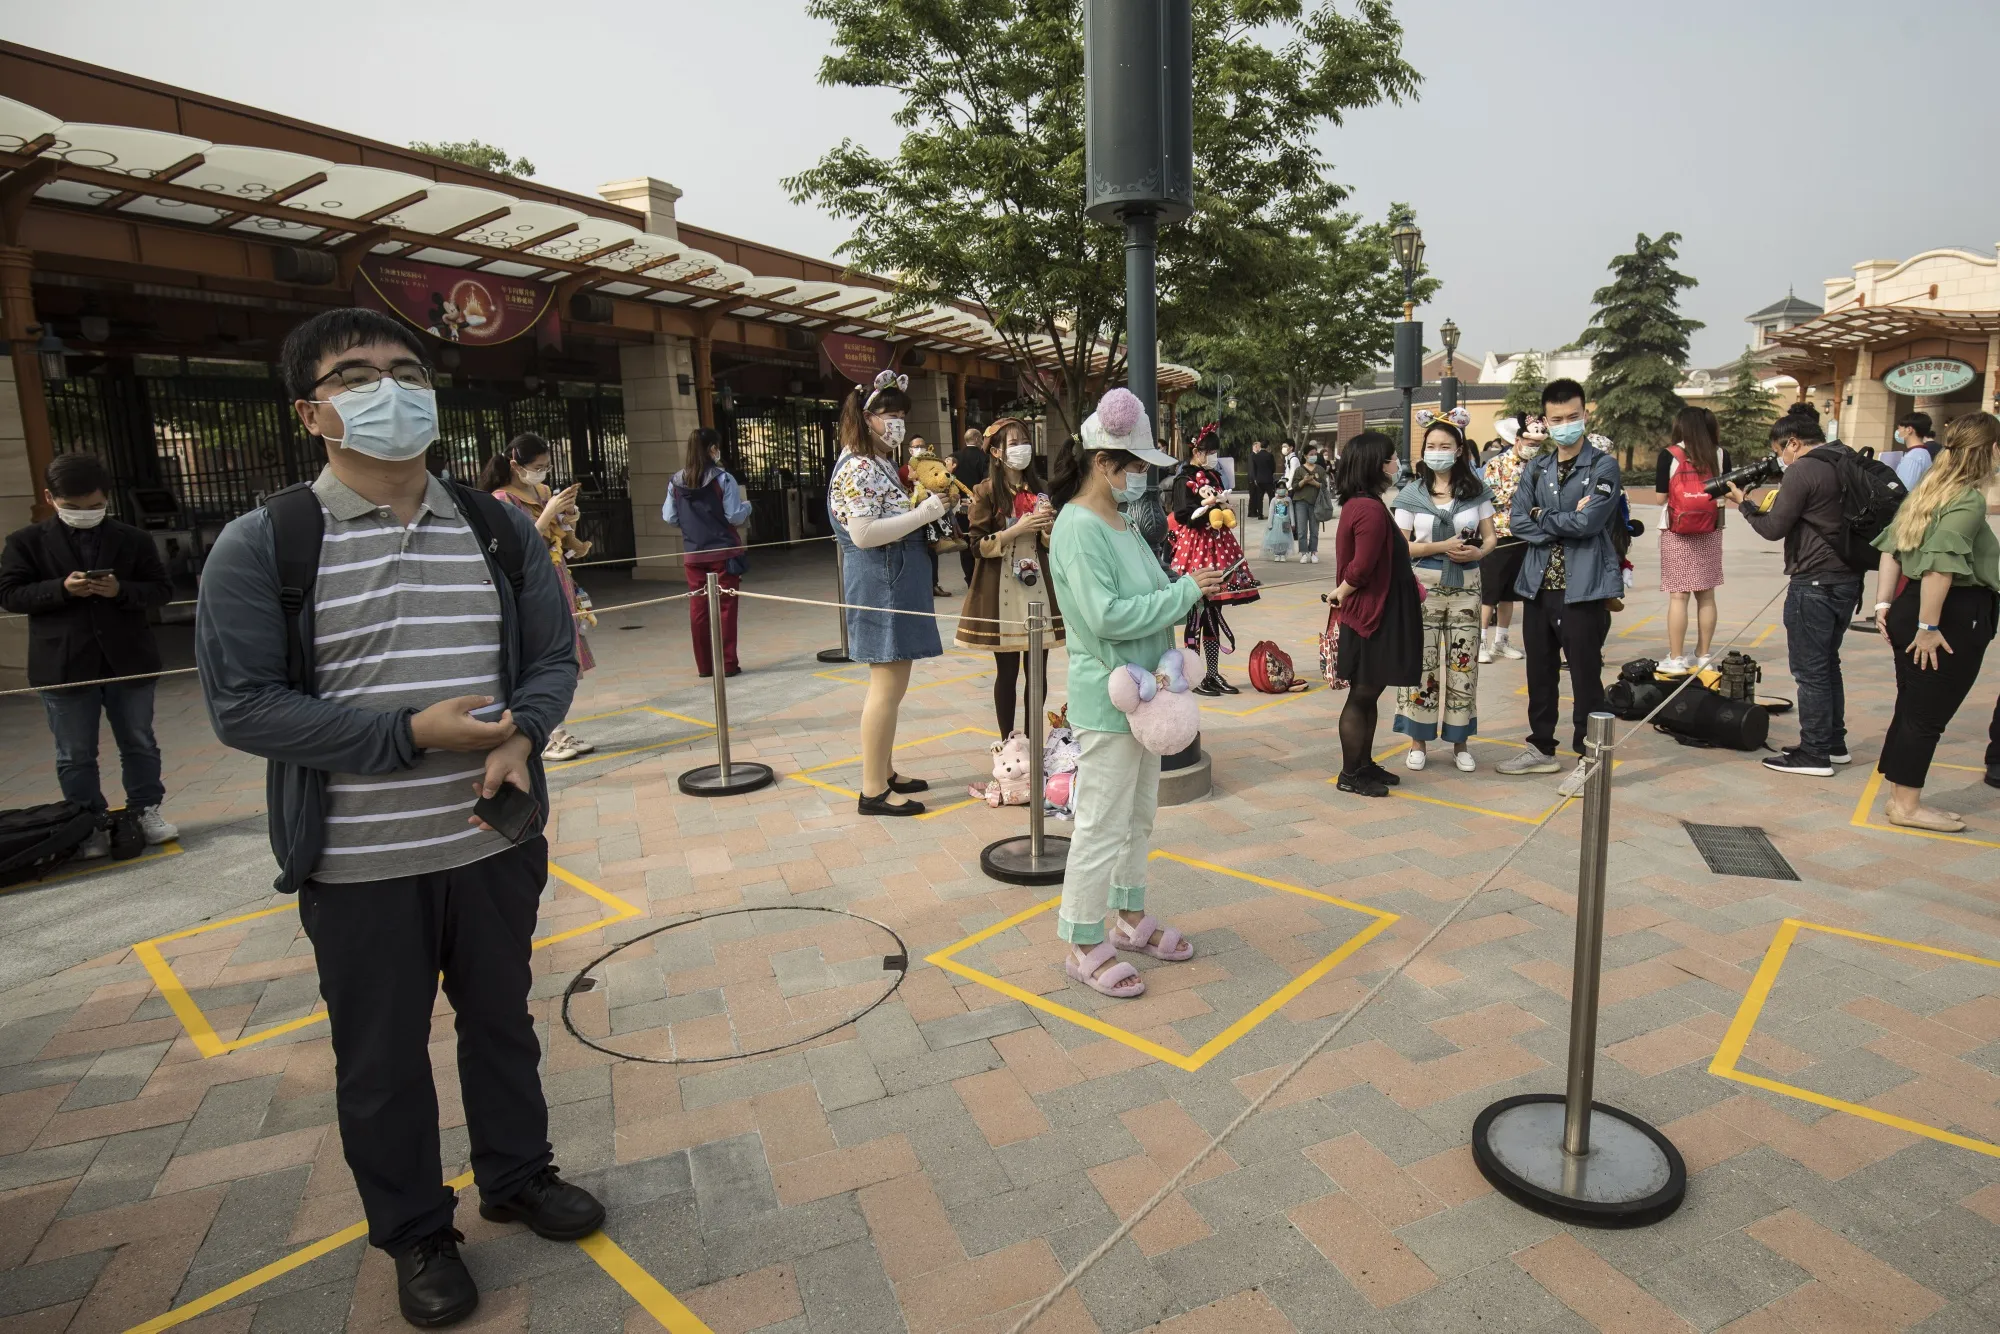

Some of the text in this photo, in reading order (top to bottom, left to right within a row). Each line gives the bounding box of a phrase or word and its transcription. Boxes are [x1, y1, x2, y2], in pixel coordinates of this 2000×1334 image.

[380, 278, 410, 286] ANNUAL
[1888, 381, 1911, 393] STROLLER
[1916, 386, 1949, 394] WHEELCHAIR
[1951, 377, 1969, 389] RENTAL
